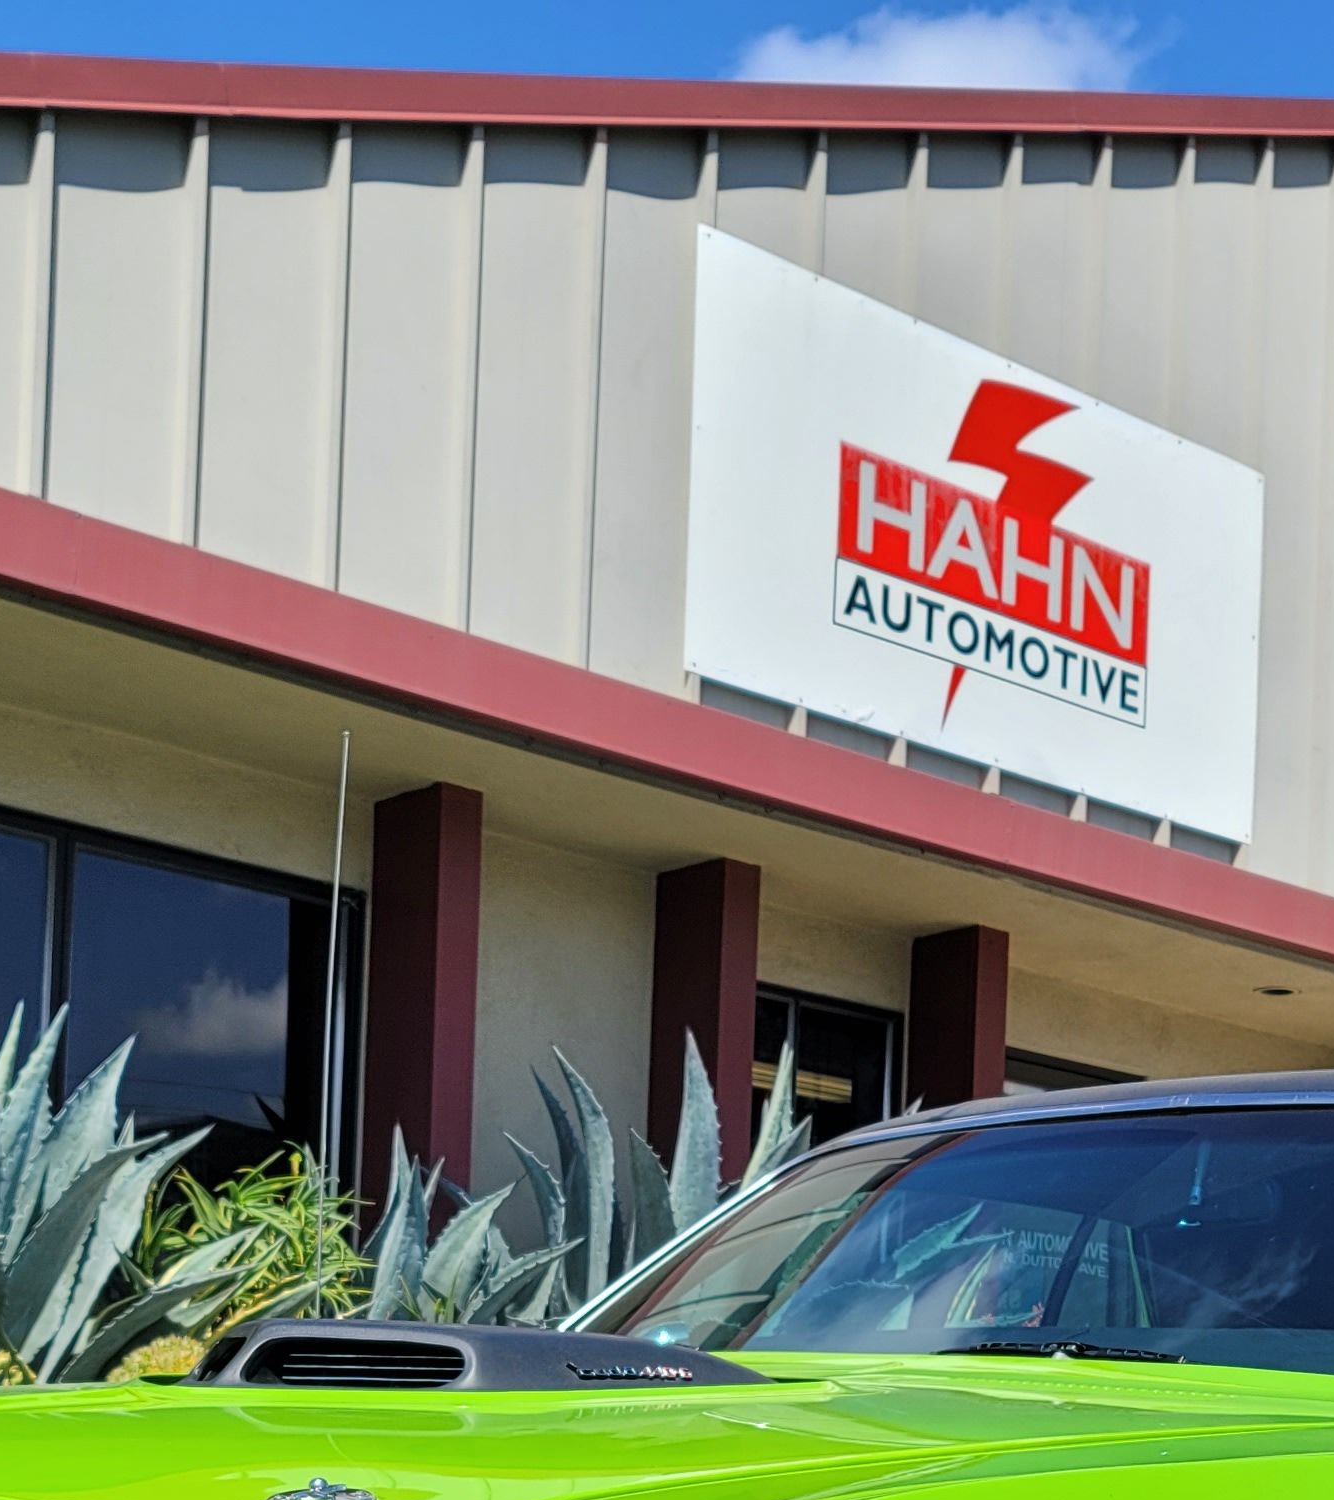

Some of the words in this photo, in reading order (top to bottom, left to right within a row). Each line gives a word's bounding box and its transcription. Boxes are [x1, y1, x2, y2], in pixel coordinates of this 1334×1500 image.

[856, 459, 1135, 651] HAHN
[843, 575, 1139, 714] AUTOMOTIVE
[1019, 1229, 1109, 1263] AUTOMIVE
